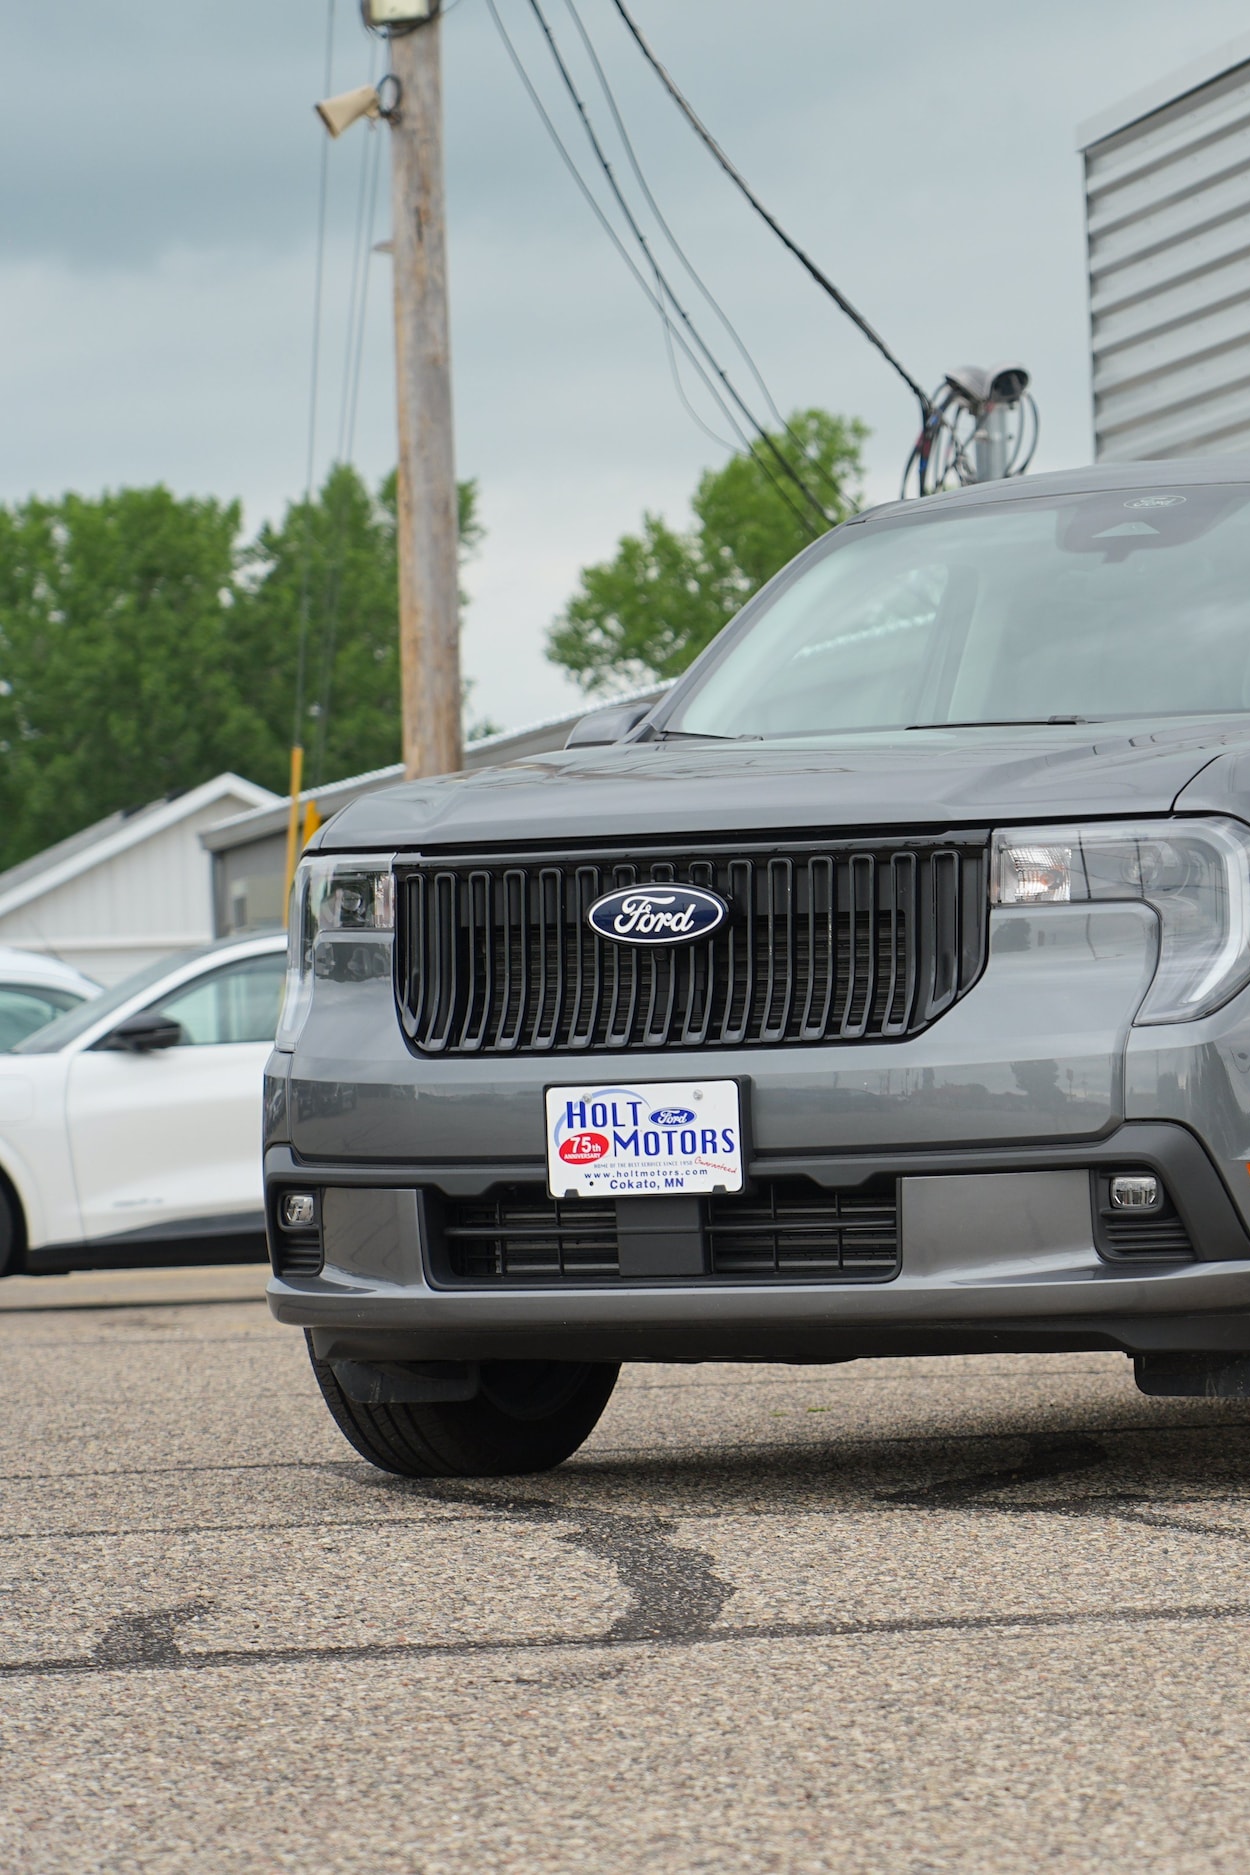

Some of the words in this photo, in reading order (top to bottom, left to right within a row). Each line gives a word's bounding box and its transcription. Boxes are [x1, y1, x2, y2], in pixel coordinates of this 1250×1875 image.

[614, 895, 696, 933] Ford
[566, 1101, 642, 1129] HOLT
[657, 1110, 687, 1124] Ford
[569, 1136, 602, 1154] 75th
[613, 1128, 735, 1157] MOTORS
[584, 1168, 708, 1179] www.holtmotors.com
[609, 1179, 660, 1190] Cokato,
[664, 1177, 684, 1188] MN
